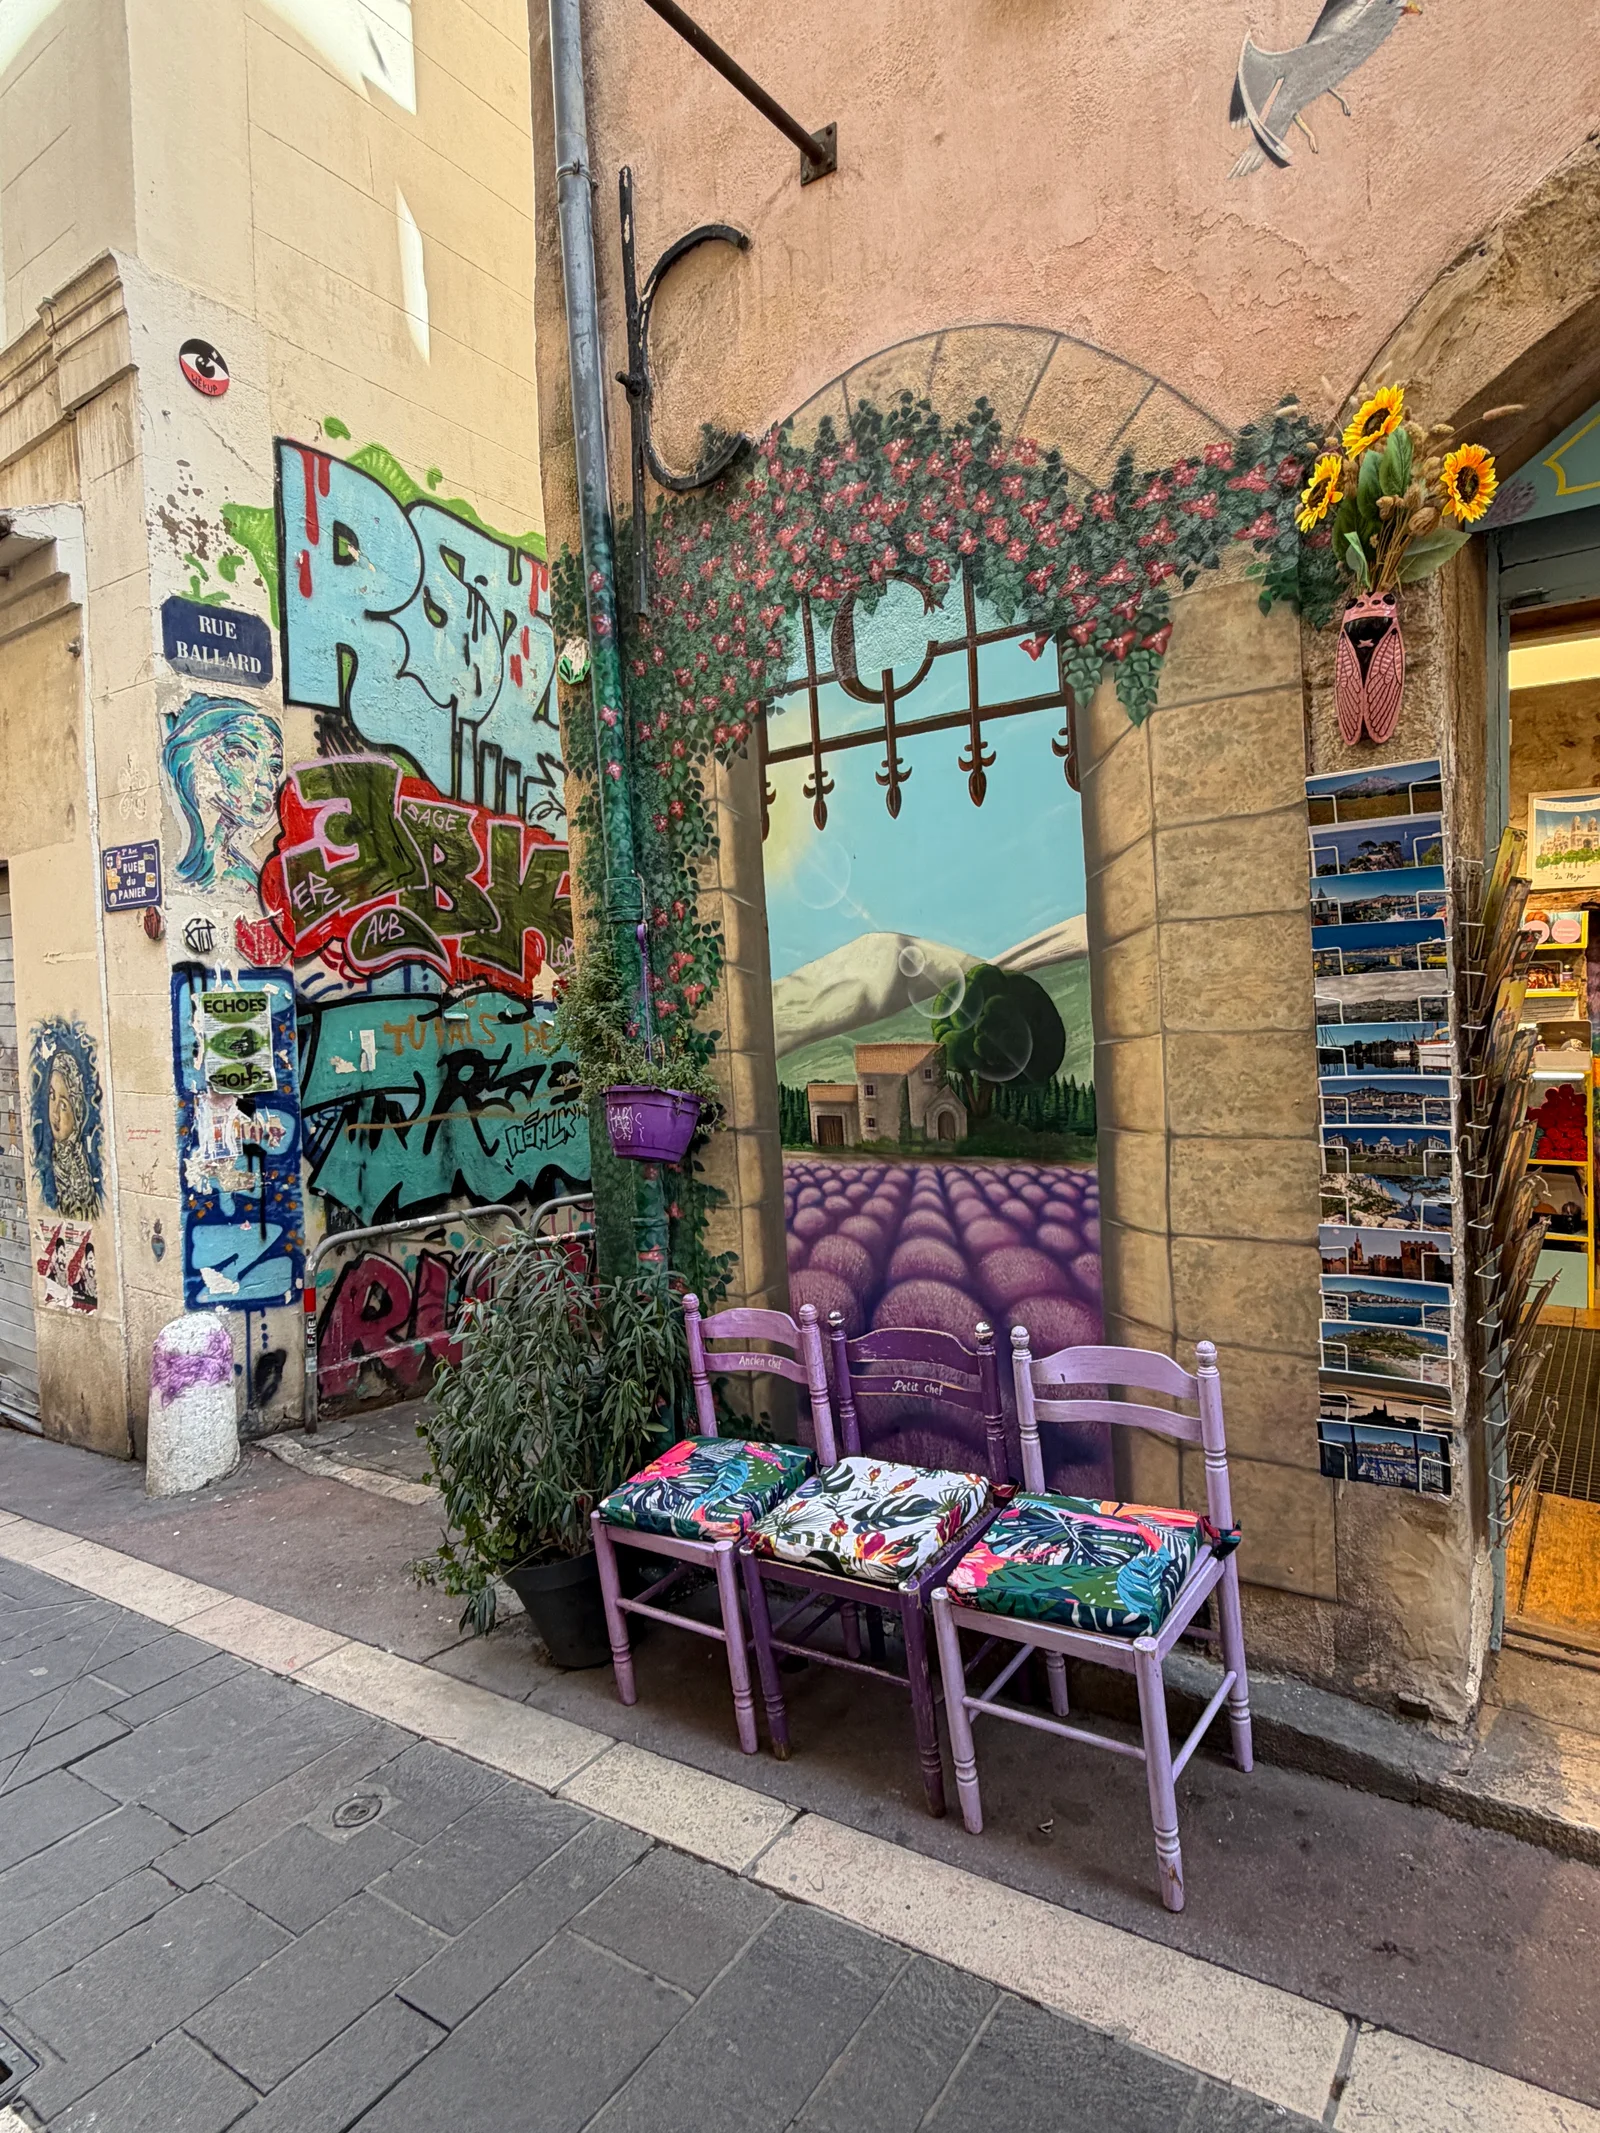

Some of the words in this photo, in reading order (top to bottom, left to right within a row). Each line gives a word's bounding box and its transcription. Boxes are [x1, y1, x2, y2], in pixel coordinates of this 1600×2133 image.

[198, 615, 238, 640] RUE
[176, 640, 262, 674] BALLARD
[122, 861, 138, 874] RUE
[126, 875, 136, 886] du
[118, 887, 147, 901] PANIER
[203, 998, 267, 1014] ECHOES
[738, 1355, 765, 1367] Ancien
[767, 1355, 782, 1370] chef
[891, 1380, 919, 1393] Petit
[924, 1381, 944, 1397] chef
